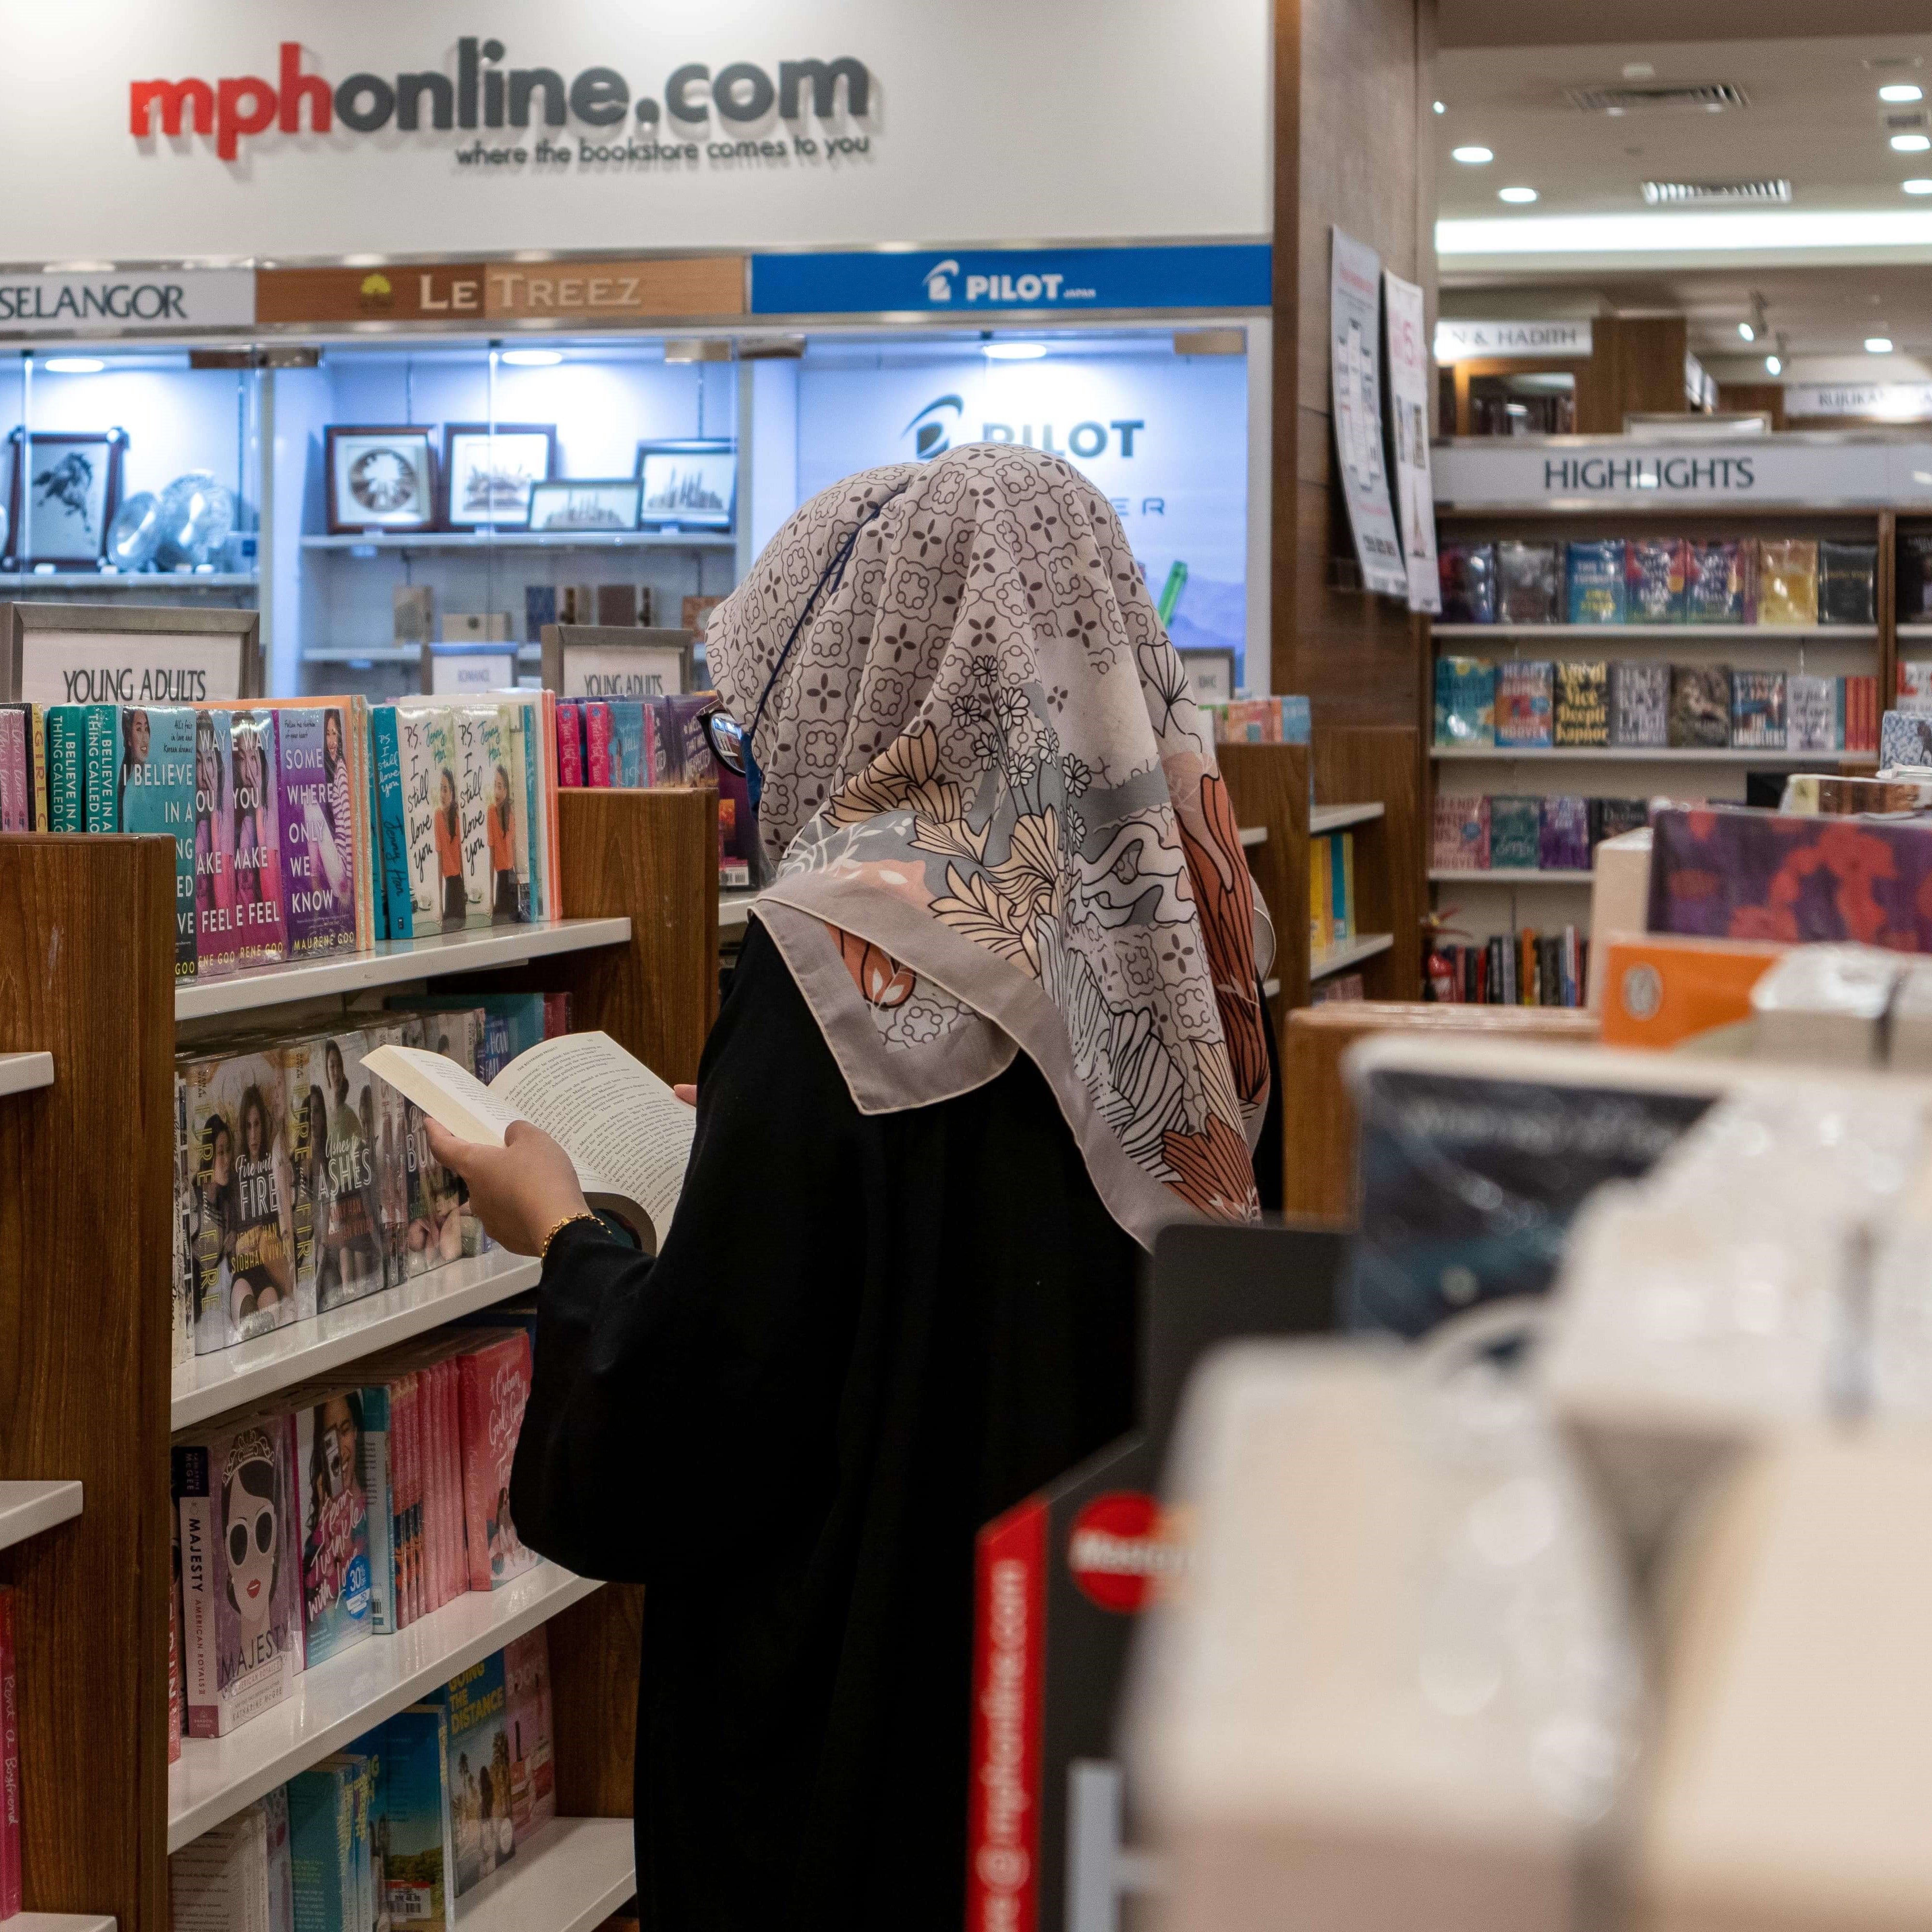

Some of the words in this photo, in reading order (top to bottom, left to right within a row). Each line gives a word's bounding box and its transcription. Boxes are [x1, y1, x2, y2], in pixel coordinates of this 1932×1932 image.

[130, 37, 868, 159] mphonline.com
[455, 140, 527, 165] where
[536, 140, 570, 163] the
[581, 137, 698, 161] bookstore
[707, 140, 786, 159] comes
[793, 136, 817, 155] to
[824, 137, 868, 157] you
[966, 275, 1062, 300] PILOT
[0, 283, 188, 320] SELANGOR
[1498, 326, 1577, 346] HADITH
[982, 420, 1144, 457] PILOT
[1546, 457, 1754, 489] HIGHLIGHTS
[63, 669, 133, 702] YOUNG
[140, 669, 206, 702] ADULTS
[584, 674, 622, 696] YOUNG
[626, 674, 663, 696] ADULTS
[54, 716, 62, 758] THING
[88, 714, 98, 756] THING
[199, 730, 226, 751] WAY
[243, 729, 270, 750] WAY
[66, 742, 76, 798] BELIEVE
[102, 739, 112, 796] BELIEVE
[285, 748, 324, 769] SOME
[378, 751, 398, 770] still
[411, 755, 418, 781] I
[463, 752, 472, 778] I
[89, 761, 99, 812] CALLED
[124, 764, 126, 786] I
[135, 764, 192, 785] BELIEVE
[379, 770, 399, 784] love
[460, 765, 483, 809] still
[54, 764, 63, 814] CALLED
[196, 790, 214, 812] OU
[233, 787, 258, 809] YOU
[287, 783, 334, 805] WHERE
[381, 781, 399, 797] you
[408, 768, 429, 813] still
[66, 804, 76, 818] IN
[102, 802, 112, 816] IN
[165, 801, 179, 823] IN
[185, 802, 193, 822] A
[66, 823, 76, 832] A
[103, 822, 112, 831] A
[289, 822, 324, 843] ONLY
[411, 814, 432, 849] love
[461, 810, 484, 843] love
[197, 851, 222, 875] AKE
[235, 846, 268, 869] MAKE
[290, 856, 311, 878] WE
[413, 843, 433, 883] you
[465, 837, 484, 877] you
[249, 901, 279, 924] FEEL
[292, 889, 333, 914] KNOW
[202, 909, 232, 933] FEEL
[294, 934, 334, 951] MAURENE
[338, 931, 354, 944] GOO
[217, 952, 235, 965] GOO
[294, 1085, 313, 1162] FIRE
[195, 1104, 215, 1187] FIRE
[318, 1149, 372, 1201] ASHES
[240, 1173, 279, 1221] FIRE
[296, 1204, 314, 1282] FIRE
[199, 1229, 219, 1312] FIRE
[231, 1250, 265, 1274] SIOBHAN
[188, 1518, 203, 1592] MAJESTY
[308, 1578, 334, 1622] with
[222, 1625, 289, 1683] MAJESTY
[4, 1676, 16, 1719] Rent
[450, 1689, 469, 1712] THE
[451, 1686, 504, 1736] DISTANCE
[5, 1757, 19, 1826] Boyfriend
